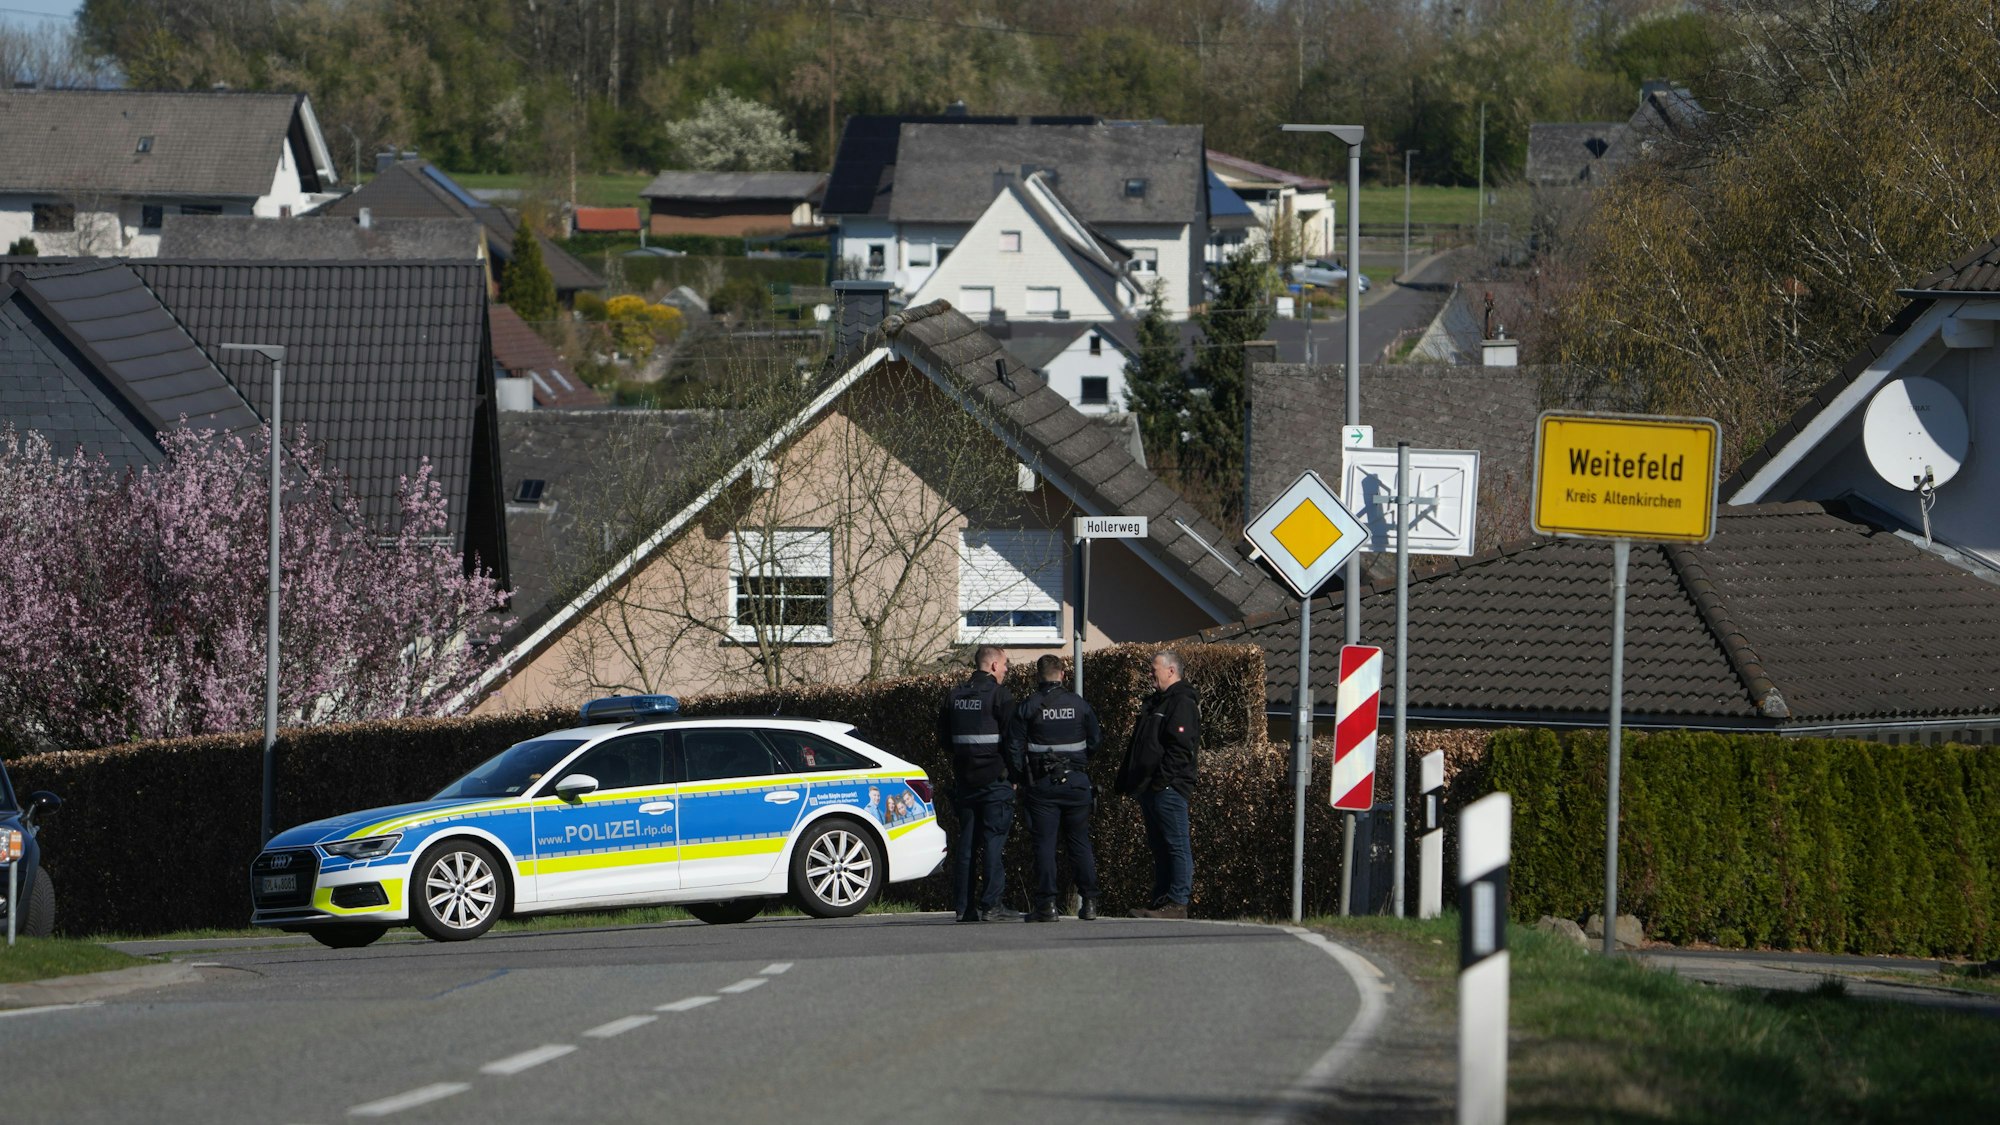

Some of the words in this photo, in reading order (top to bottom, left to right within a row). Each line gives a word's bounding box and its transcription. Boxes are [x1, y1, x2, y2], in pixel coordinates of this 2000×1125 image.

[1569, 448, 1684, 481] Weitefeld
[1566, 488, 1597, 503] Kreis
[1604, 490, 1682, 508] Altenkirchen
[1087, 520, 1140, 536] Hollerweg
[954, 699, 982, 710] POLIZEI
[1042, 707, 1075, 720] POLIZEI
